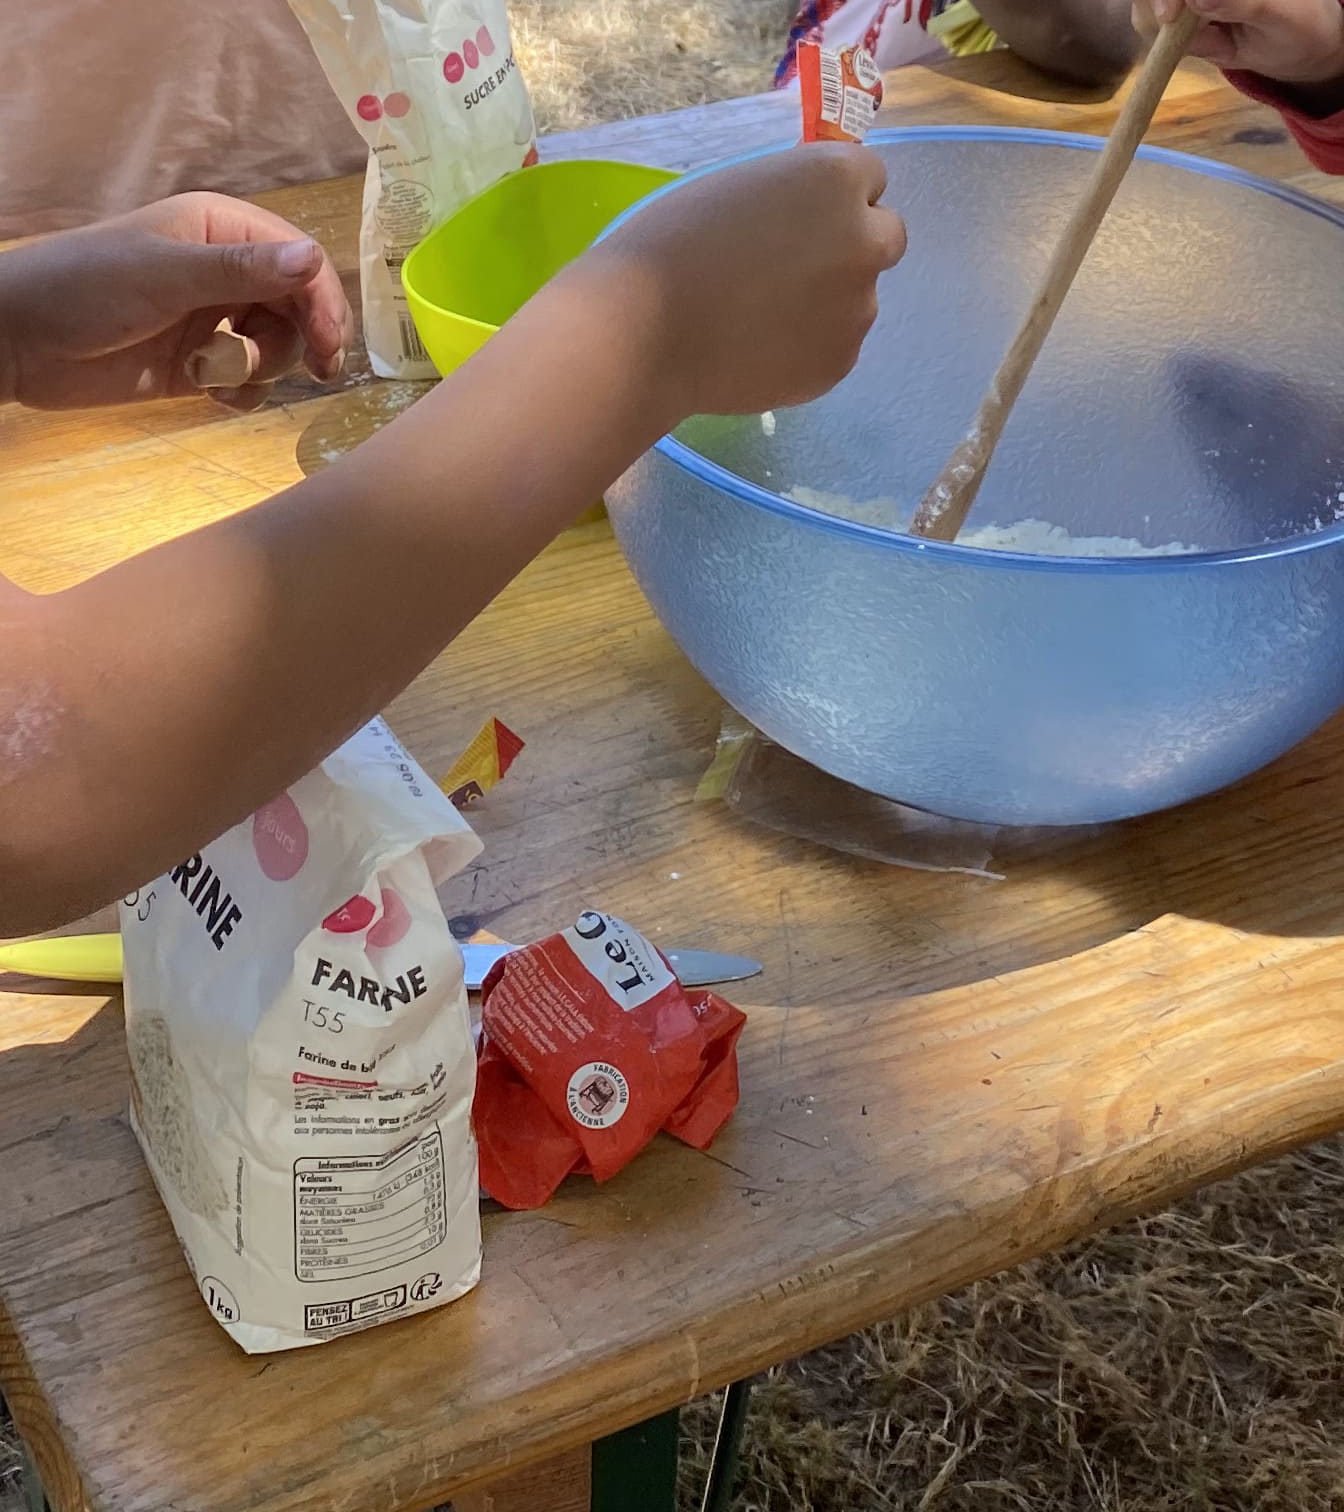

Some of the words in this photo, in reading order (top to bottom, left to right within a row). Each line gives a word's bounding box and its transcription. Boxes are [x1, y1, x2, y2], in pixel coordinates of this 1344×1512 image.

[463, 77, 497, 110] SUCRE
[168, 852, 243, 951] RINE
[605, 938, 646, 995] Le
[625, 939, 655, 982] MAISON
[303, 1000, 347, 1034] T55
[297, 1046, 337, 1069] Farine
[341, 1059, 357, 1071] de
[593, 1063, 628, 1104] FABRICATION
[378, 1116, 400, 1127] gras
[309, 1305, 349, 1318] PENSEZ
[309, 1316, 323, 1327] AU
